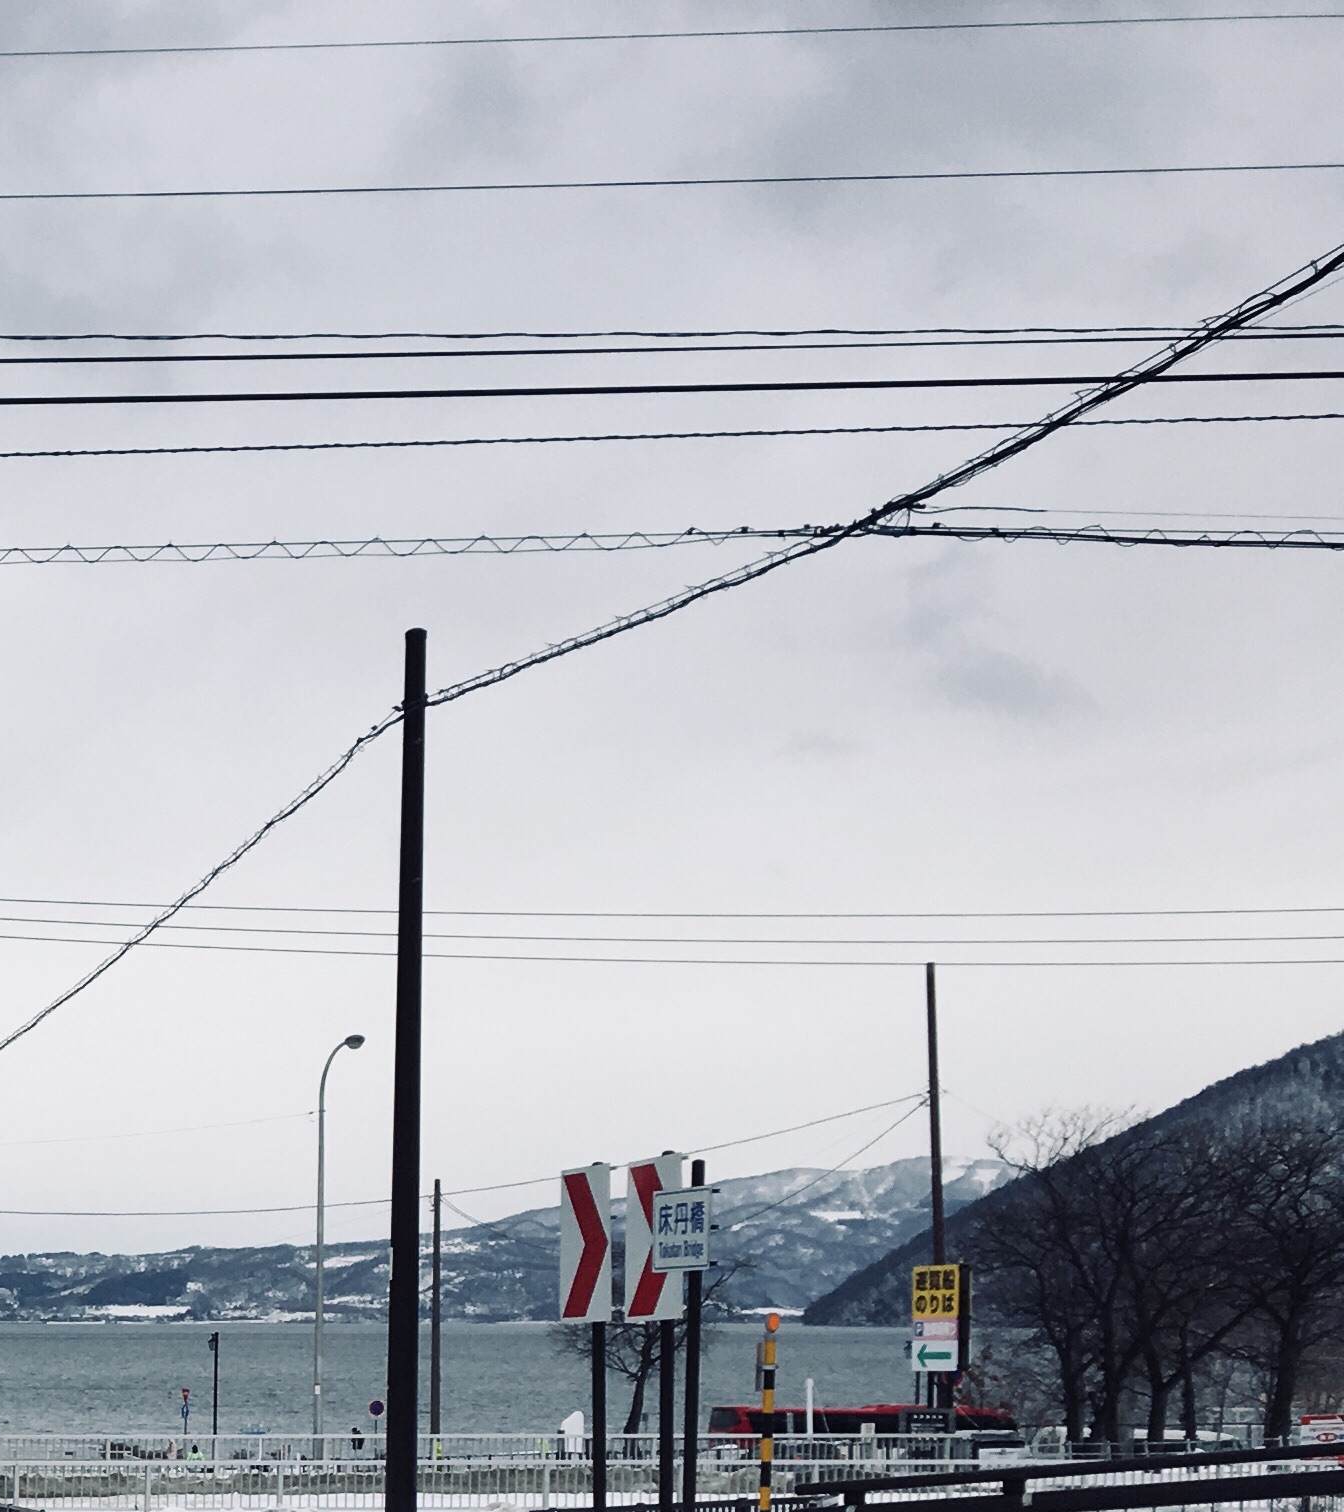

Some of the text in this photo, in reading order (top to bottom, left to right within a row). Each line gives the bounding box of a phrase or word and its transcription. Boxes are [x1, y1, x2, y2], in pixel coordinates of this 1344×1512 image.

[658, 1201, 705, 1236] 床丹橋
[915, 1293, 954, 1314] のりば
